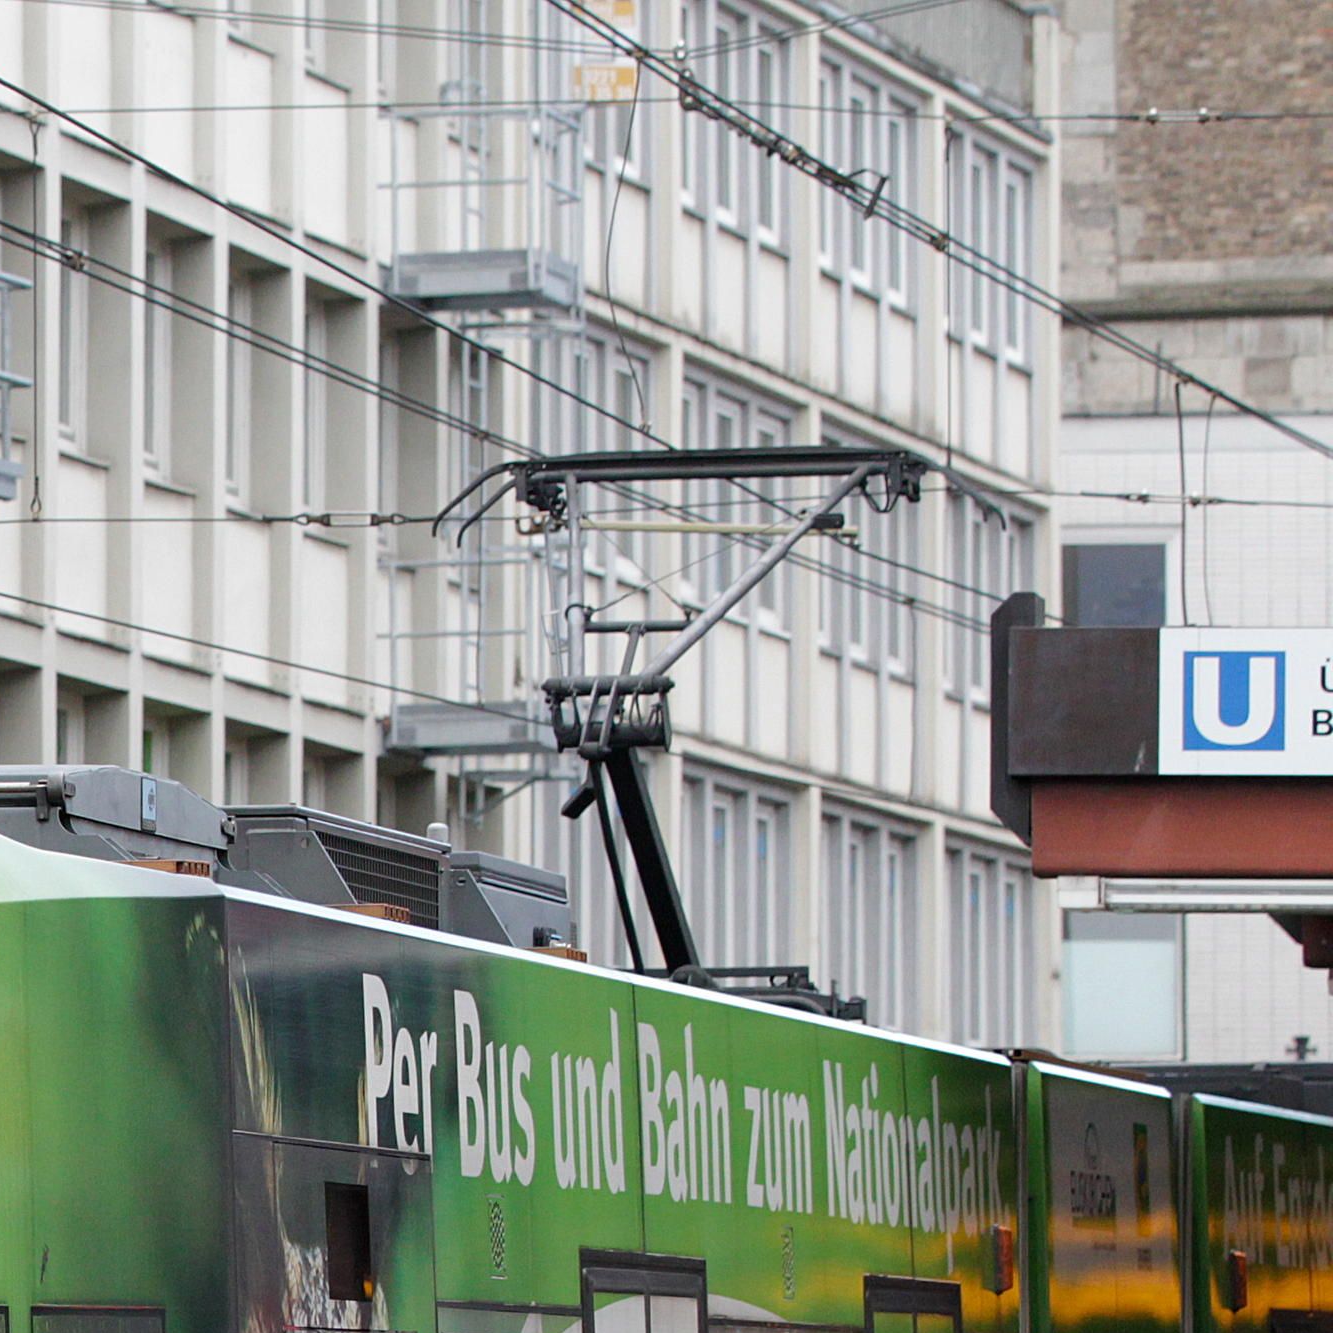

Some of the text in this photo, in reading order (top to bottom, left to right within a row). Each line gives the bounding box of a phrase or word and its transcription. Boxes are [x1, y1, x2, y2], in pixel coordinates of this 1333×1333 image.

[1192, 656, 1276, 746] U
[362, 972, 438, 1176] Per
[453, 988, 536, 1187] Bus
[550, 1007, 626, 1194] und
[637, 1021, 732, 1204] Bahn
[744, 1085, 813, 1215] zum
